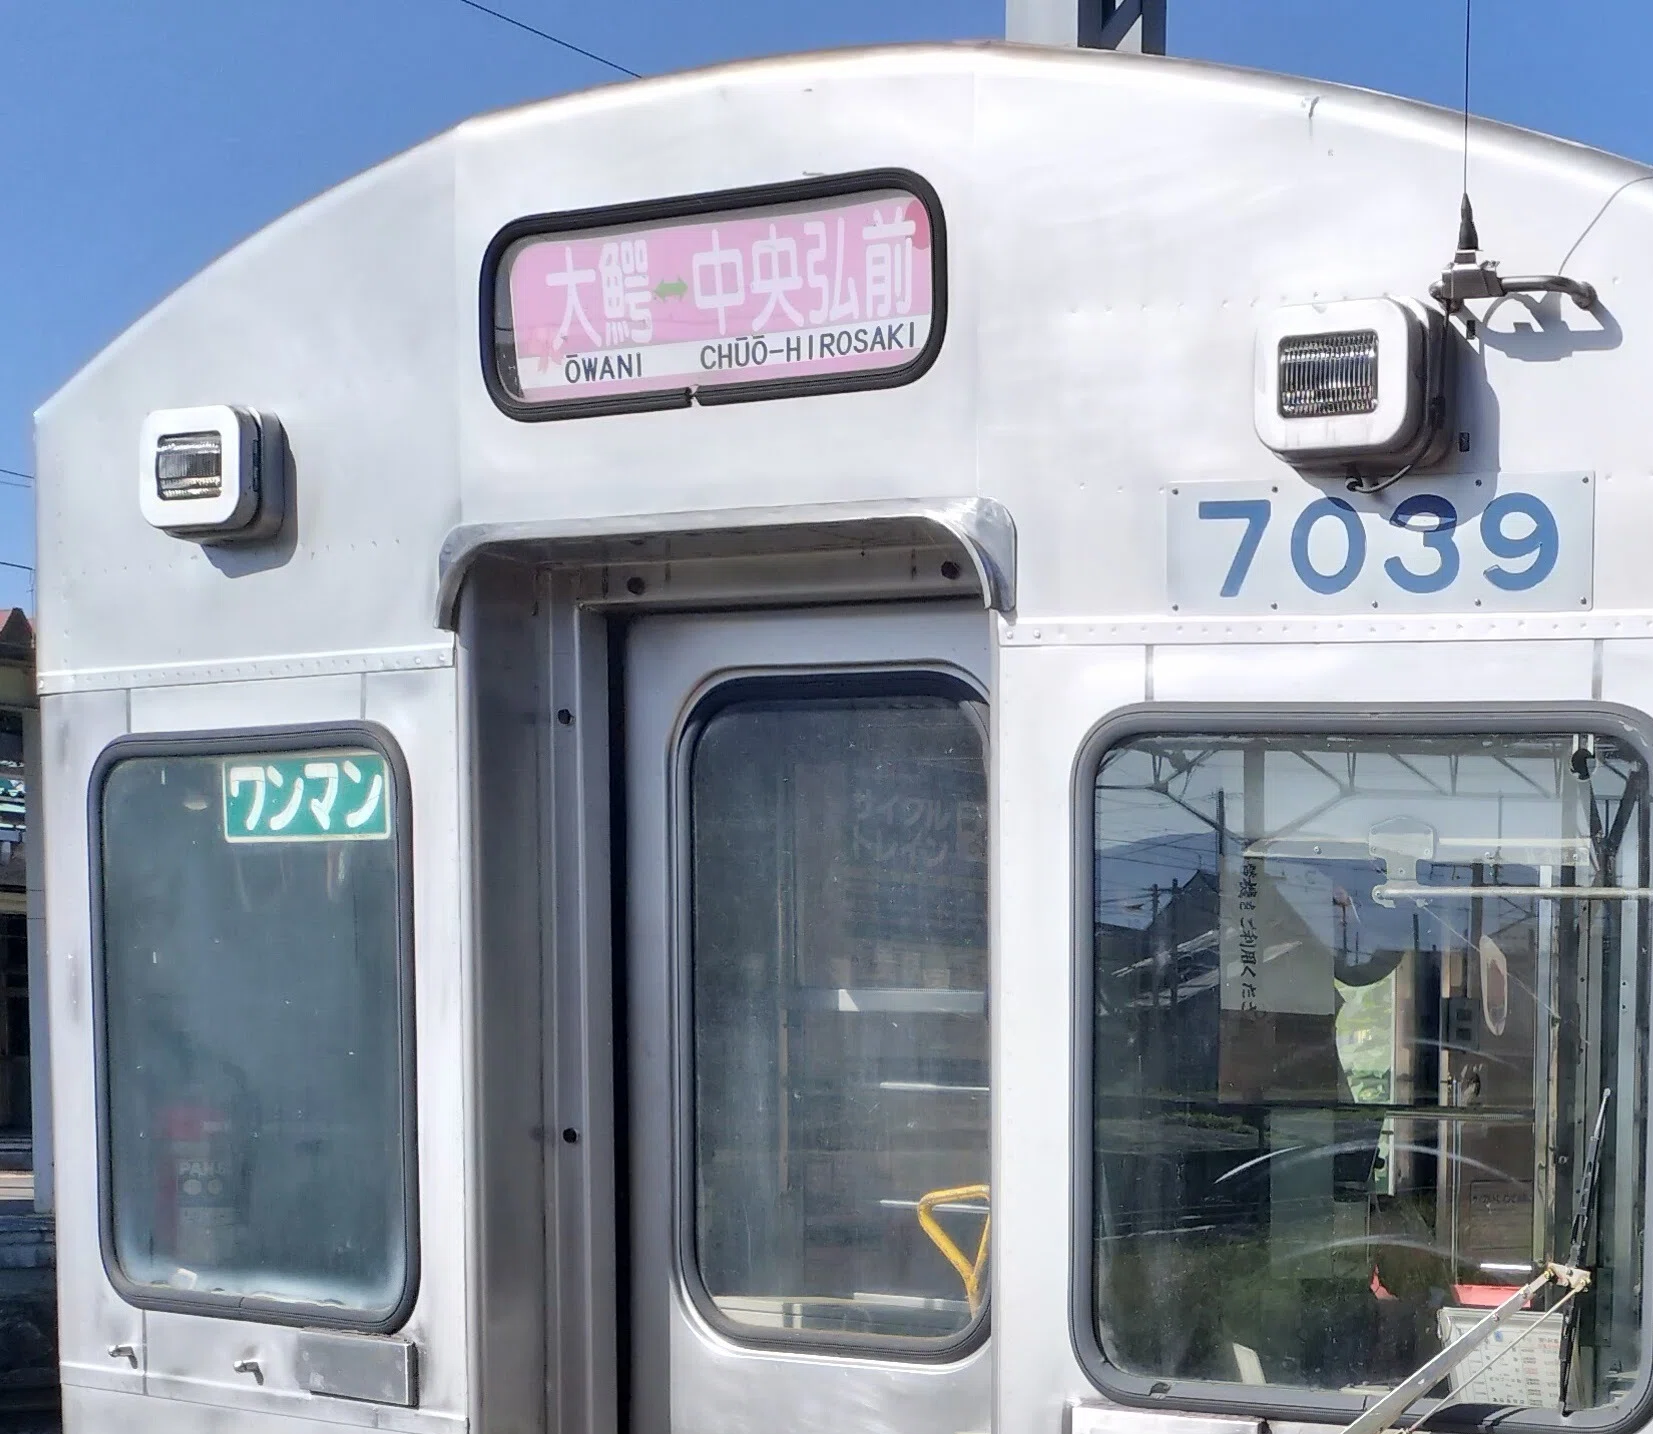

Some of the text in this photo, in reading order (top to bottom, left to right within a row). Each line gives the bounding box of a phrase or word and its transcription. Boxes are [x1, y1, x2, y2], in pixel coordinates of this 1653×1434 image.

[545, 206, 917, 351] 大鰐 中央弘前
[564, 321, 915, 384] ŌWANI CHŪŌ-HIROSAKI
[1198, 491, 1560, 598] 7039
[229, 759, 383, 832] ワンマン
